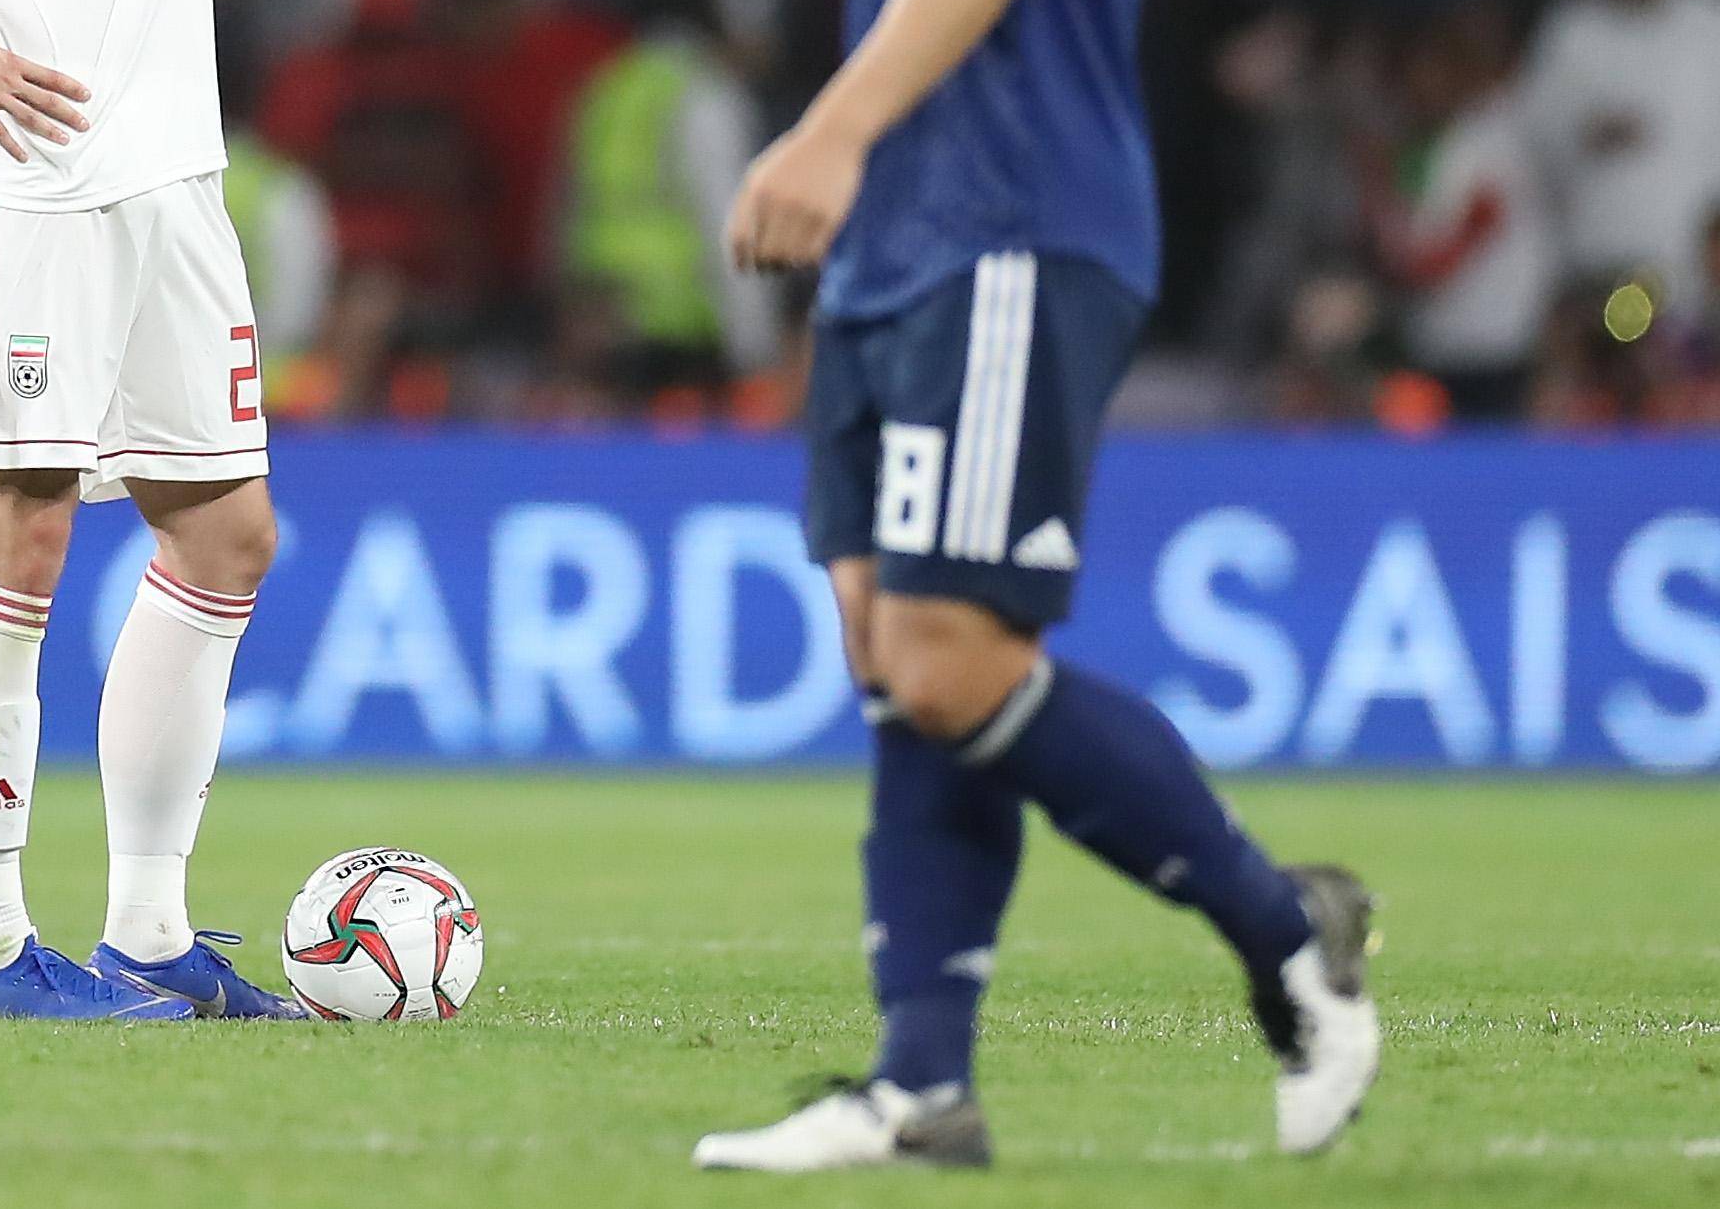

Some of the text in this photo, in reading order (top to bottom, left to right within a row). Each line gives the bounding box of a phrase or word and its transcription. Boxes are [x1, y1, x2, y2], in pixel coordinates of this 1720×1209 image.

[229, 324, 258, 423] 2
[871, 419, 948, 557] 8
[1148, 506, 1720, 771] SAIS
[335, 852, 427, 880] molten
